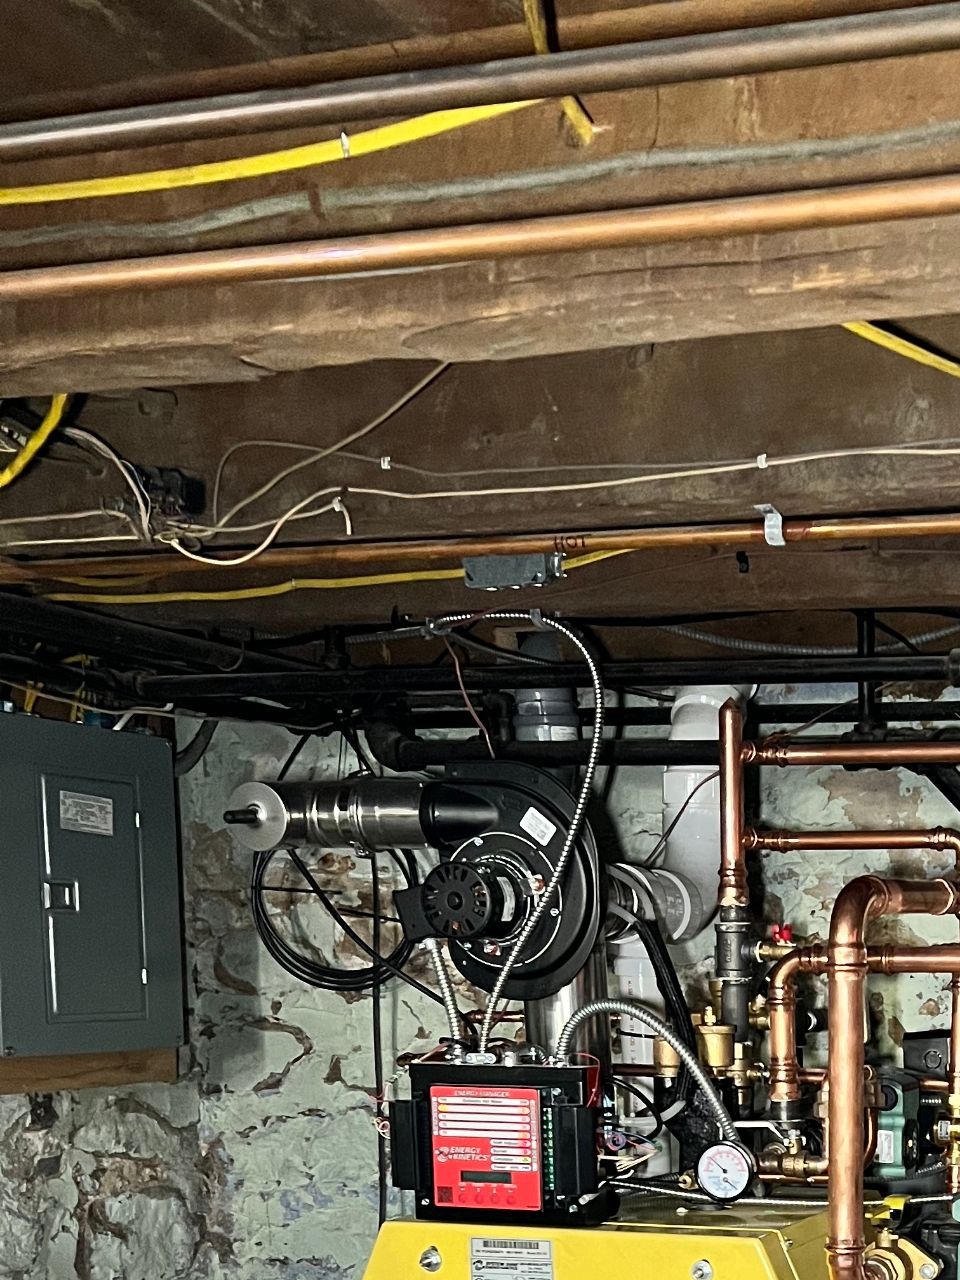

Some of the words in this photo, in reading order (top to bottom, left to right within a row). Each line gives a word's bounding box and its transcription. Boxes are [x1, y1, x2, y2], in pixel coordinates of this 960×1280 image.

[554, 535, 592, 552] HOT
[449, 1146, 480, 1154] ENERGY
[452, 1153, 488, 1161] KINETICS
